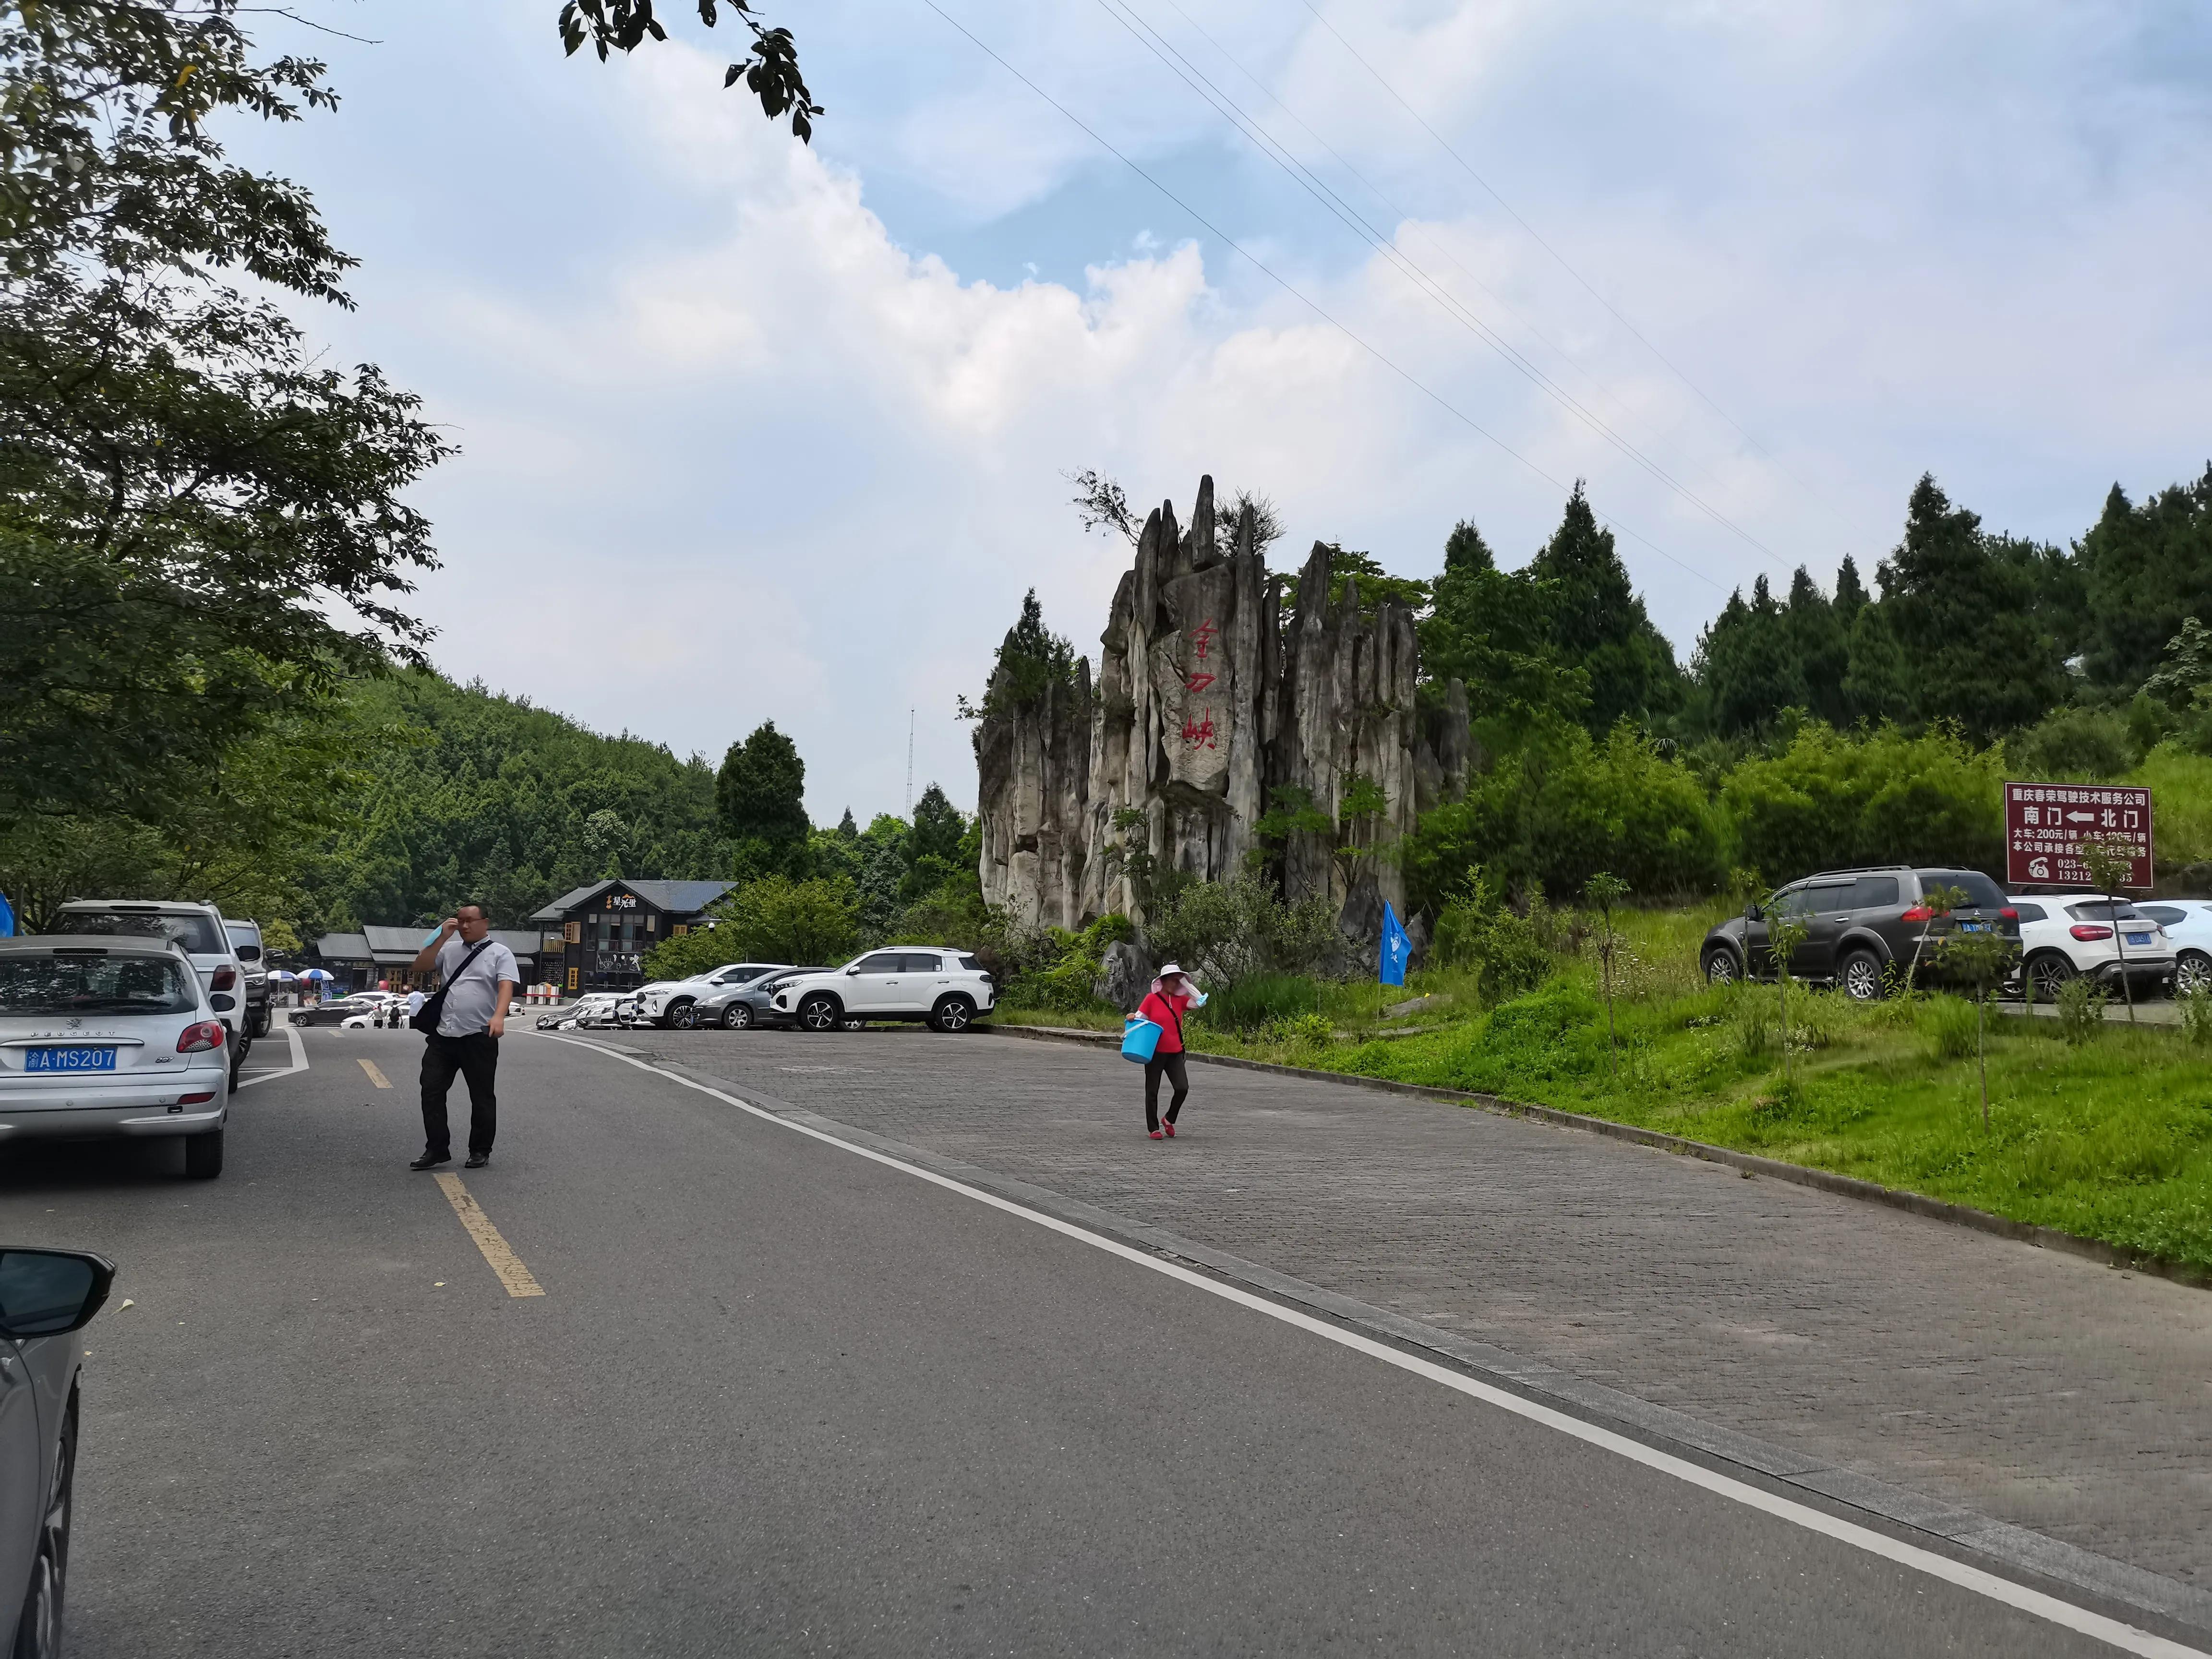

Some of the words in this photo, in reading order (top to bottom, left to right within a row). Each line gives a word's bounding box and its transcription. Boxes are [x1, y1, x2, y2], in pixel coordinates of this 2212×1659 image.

[2012, 788, 2146, 806] 重庆春荣驾驶技术服务公司
[2023, 805, 2062, 826] 南门
[2100, 808, 2139, 829] 北门
